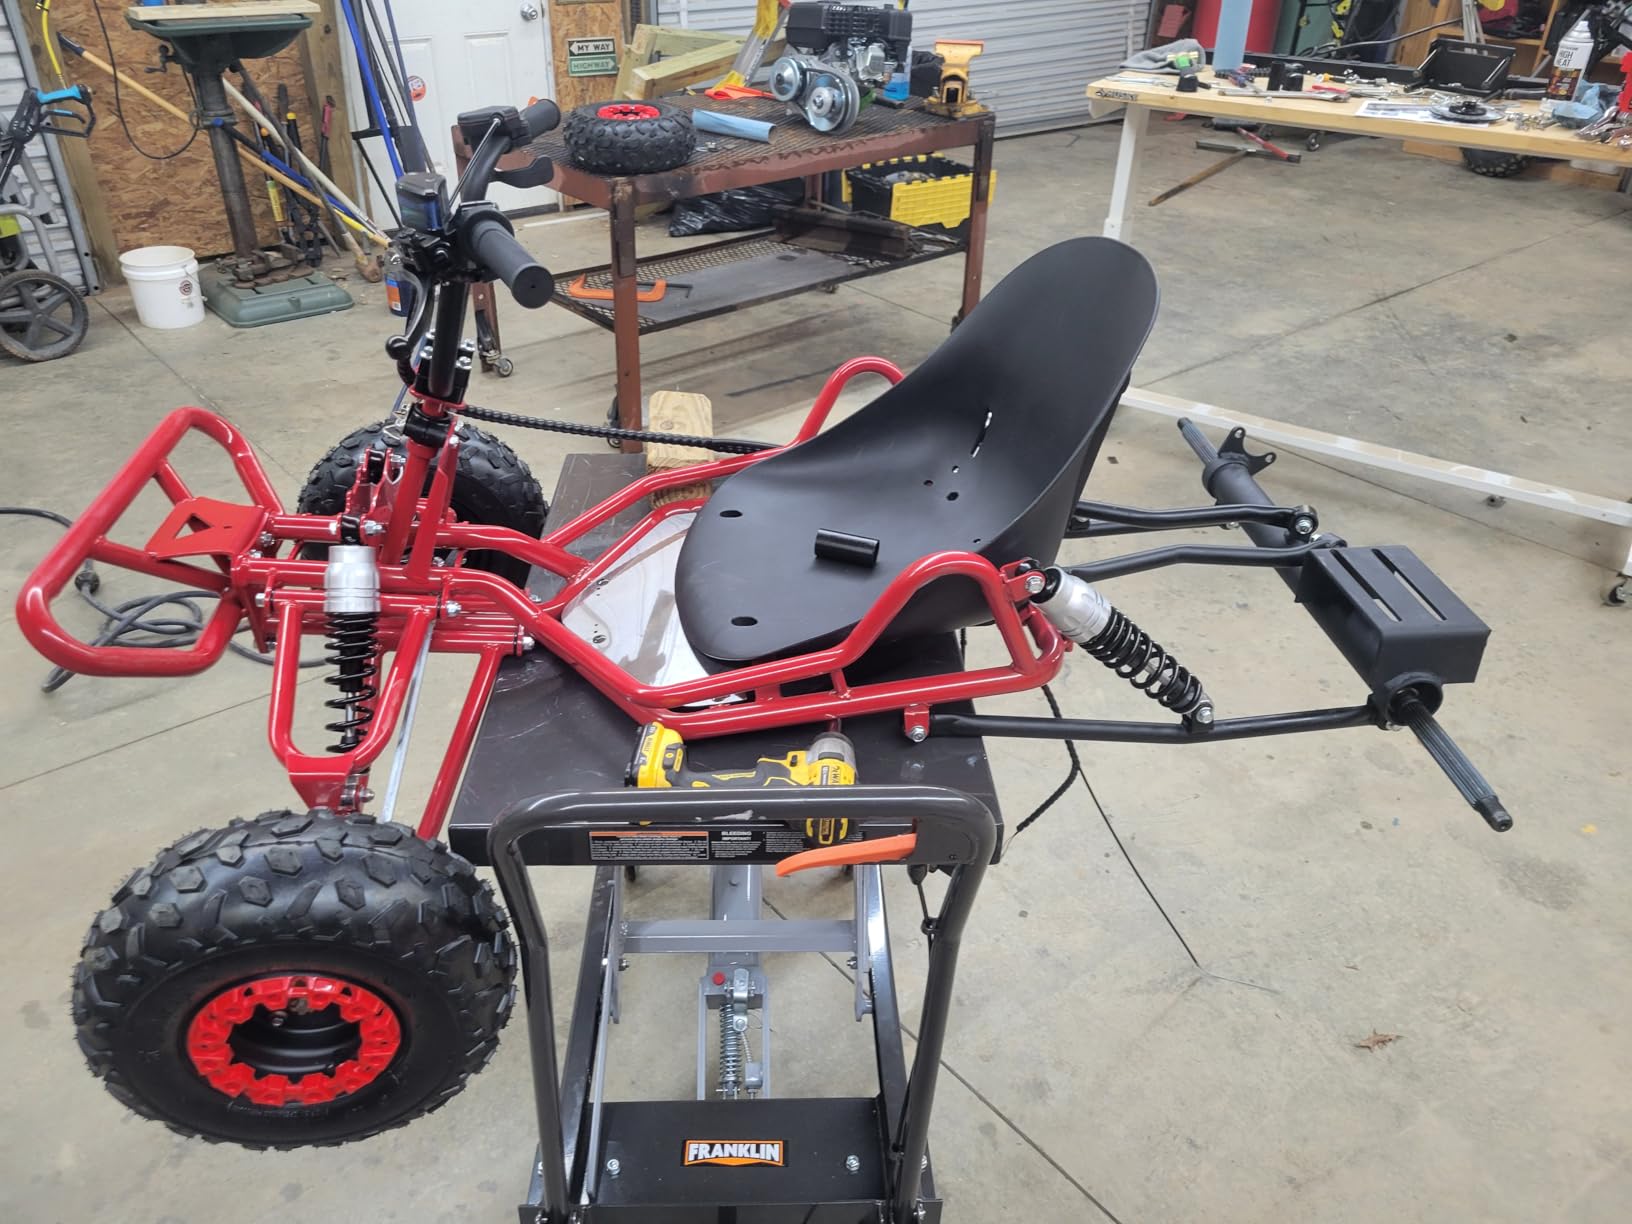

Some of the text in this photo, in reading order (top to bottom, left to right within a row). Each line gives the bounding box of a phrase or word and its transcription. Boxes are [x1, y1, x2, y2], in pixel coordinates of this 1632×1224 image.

[577, 43, 610, 52] MY WAY
[573, 61, 609, 70] HIGHWAY
[688, 1143, 780, 1162] FRANKLIN
